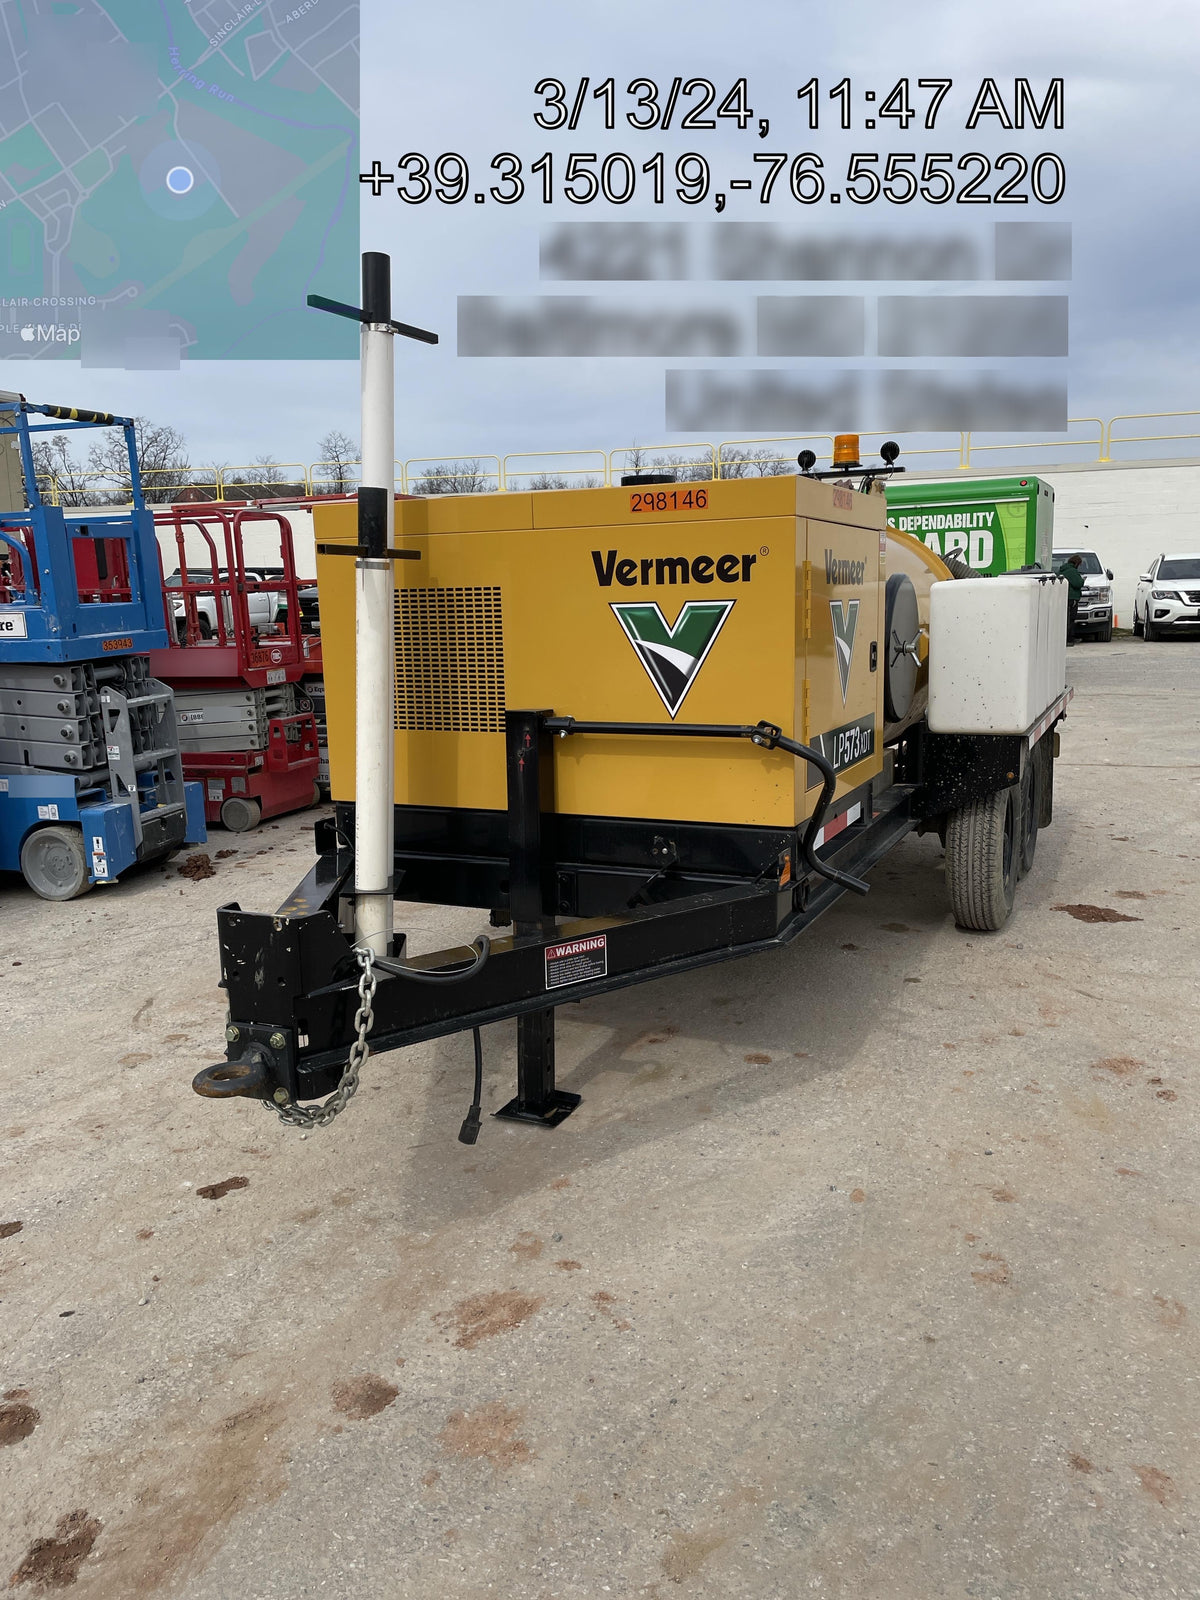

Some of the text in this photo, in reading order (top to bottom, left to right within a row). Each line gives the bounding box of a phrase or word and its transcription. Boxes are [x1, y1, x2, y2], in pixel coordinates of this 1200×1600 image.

[631, 489, 707, 512] 298146
[899, 512, 994, 531] DEPENDABILITY
[907, 530, 994, 569] ARD
[591, 550, 757, 587] Vermeer
[824, 549, 865, 585] Vermeer
[555, 938, 605, 957] WARNING
